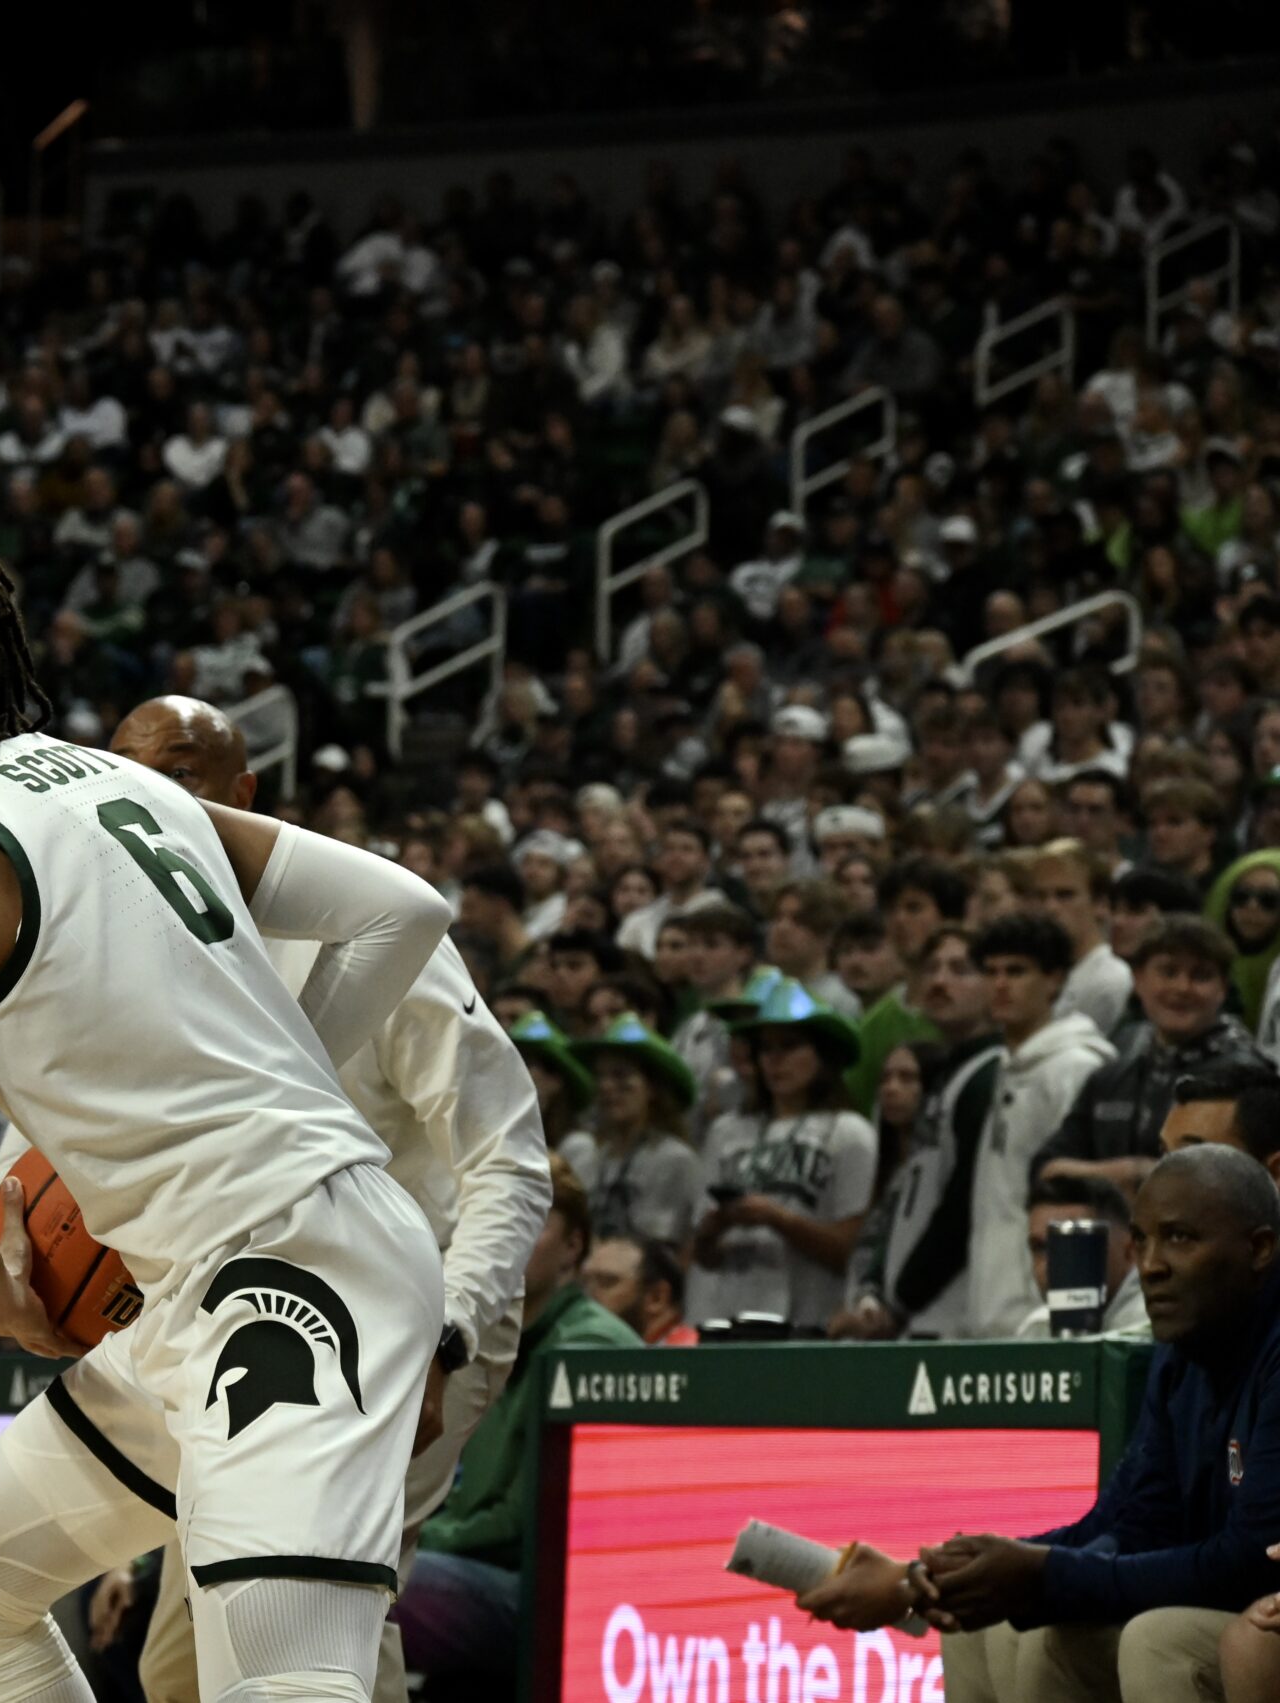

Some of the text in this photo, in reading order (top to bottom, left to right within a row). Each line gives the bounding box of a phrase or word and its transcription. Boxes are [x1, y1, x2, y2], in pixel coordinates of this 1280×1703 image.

[97, 797, 235, 944] 6
[576, 1372, 682, 1403] ACRISURE
[941, 1370, 1072, 1405] ACRISURE
[602, 1603, 730, 1703] Own
[743, 1616, 841, 1703] the
